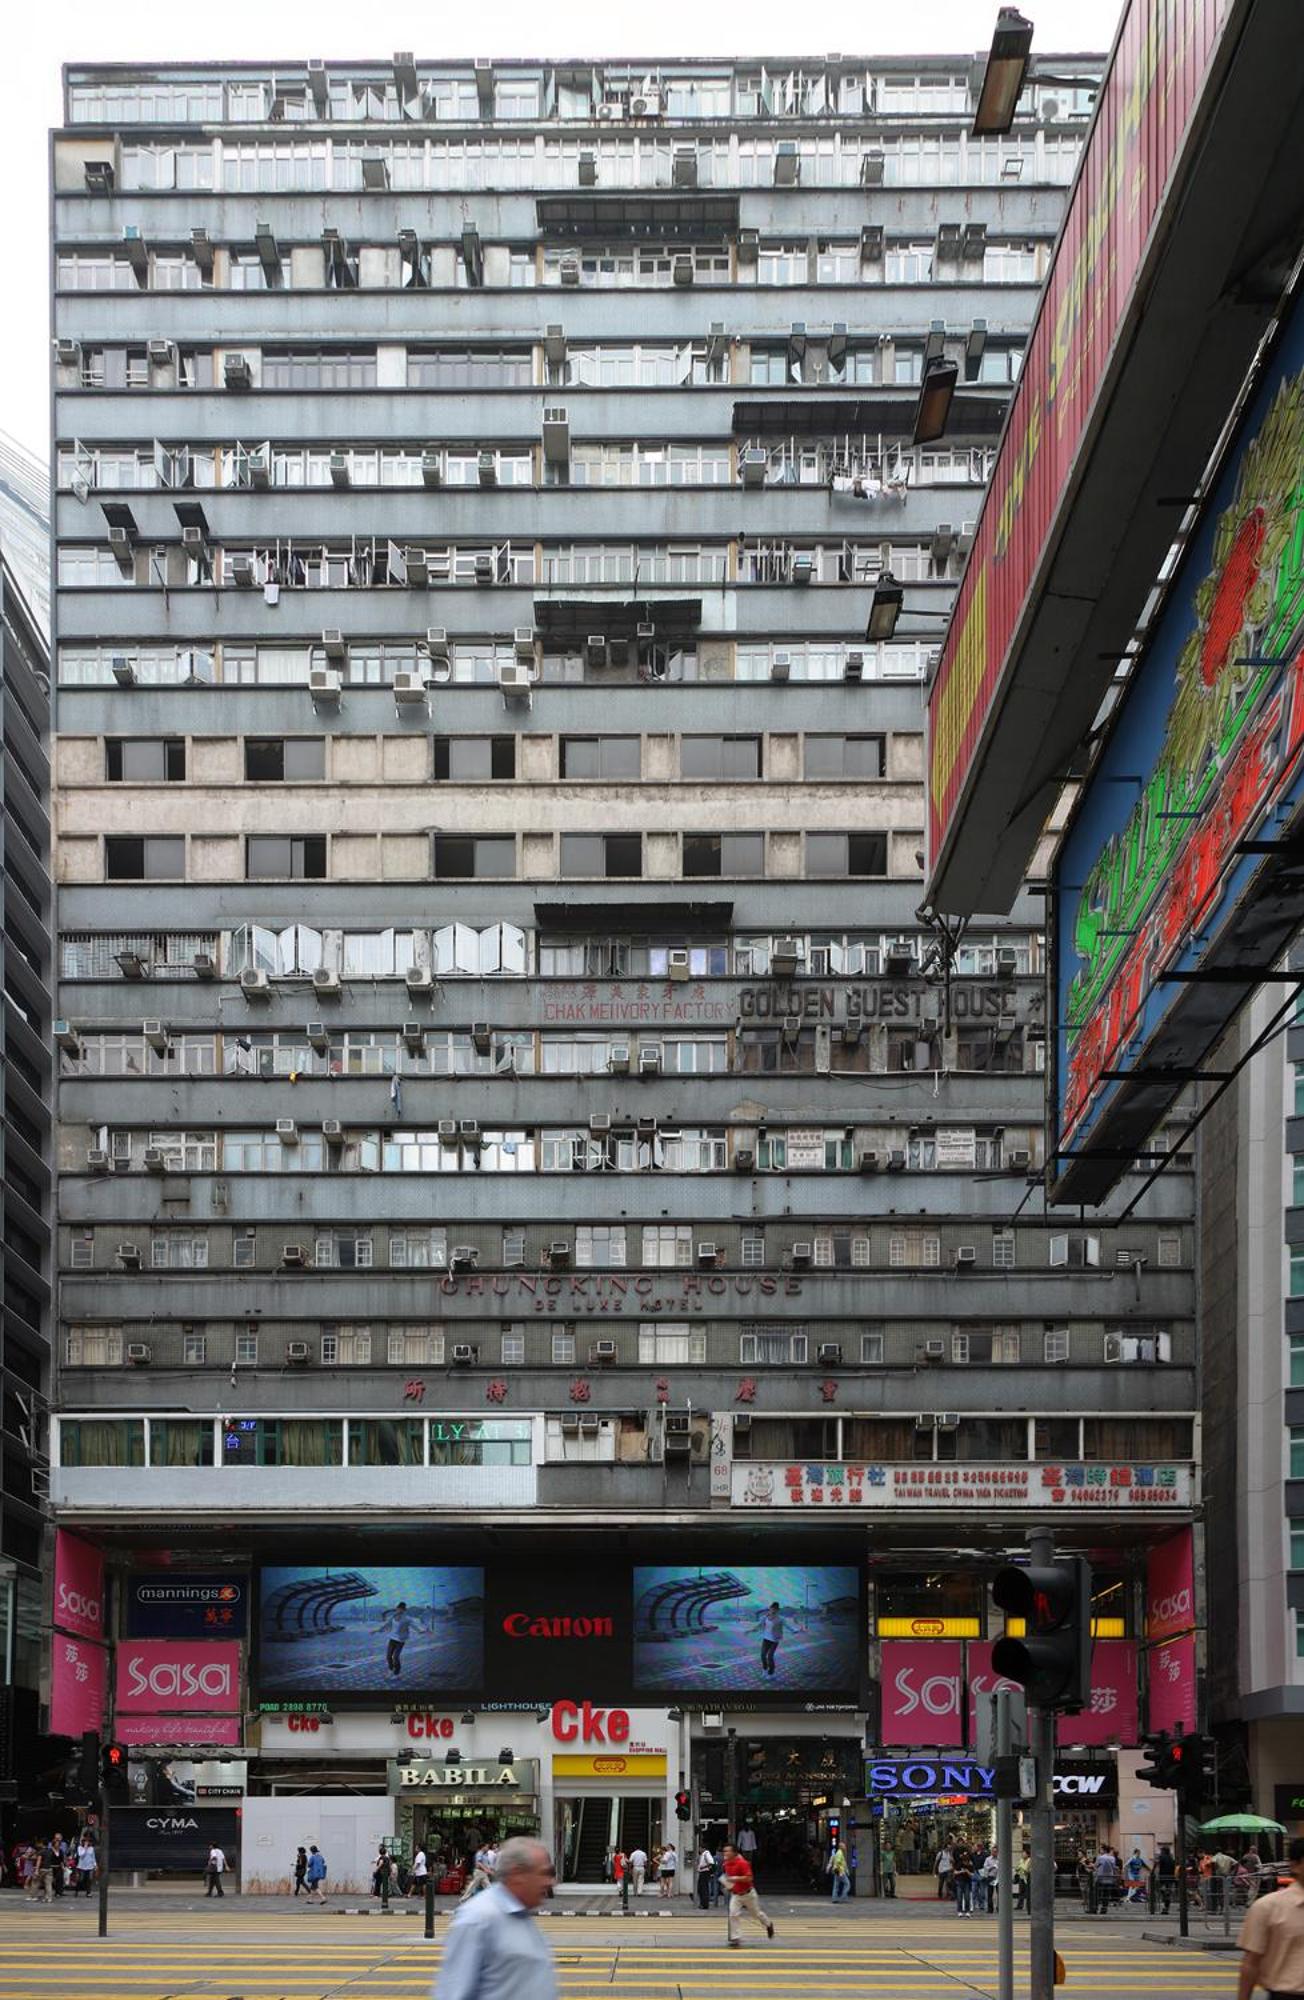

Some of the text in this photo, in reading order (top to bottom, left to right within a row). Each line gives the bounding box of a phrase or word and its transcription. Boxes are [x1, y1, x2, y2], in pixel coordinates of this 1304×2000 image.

[544, 1003, 585, 1020] CHAK
[664, 1003, 734, 1020] FACTORY
[739, 988, 834, 1017] GOLDEN
[847, 988, 925, 1017] GUEST
[440, 1277, 803, 1297] CHUNGKING HOUSE
[535, 1300, 556, 1312] DE
[573, 1300, 622, 1312] LUXE
[894, 1487, 923, 1498] TAIWAN
[924, 1487, 951, 1498] TRAVEL
[953, 1487, 974, 1498] CHINA
[59, 1583, 101, 1621] Sasa
[141, 1586, 219, 1601] mannings
[502, 1612, 613, 1638] Canon
[128, 1657, 230, 1696] Sasa
[480, 1702, 552, 1712] LIGHTHOUSE
[288, 1713, 319, 1732] Cke
[407, 1711, 454, 1738] Cke
[552, 1699, 630, 1743] Cke
[400, 1767, 519, 1787] BABILA
[870, 1765, 996, 1790] SONY
[1052, 1775, 1105, 1794] CCW
[146, 1818, 198, 1829] CYMA
